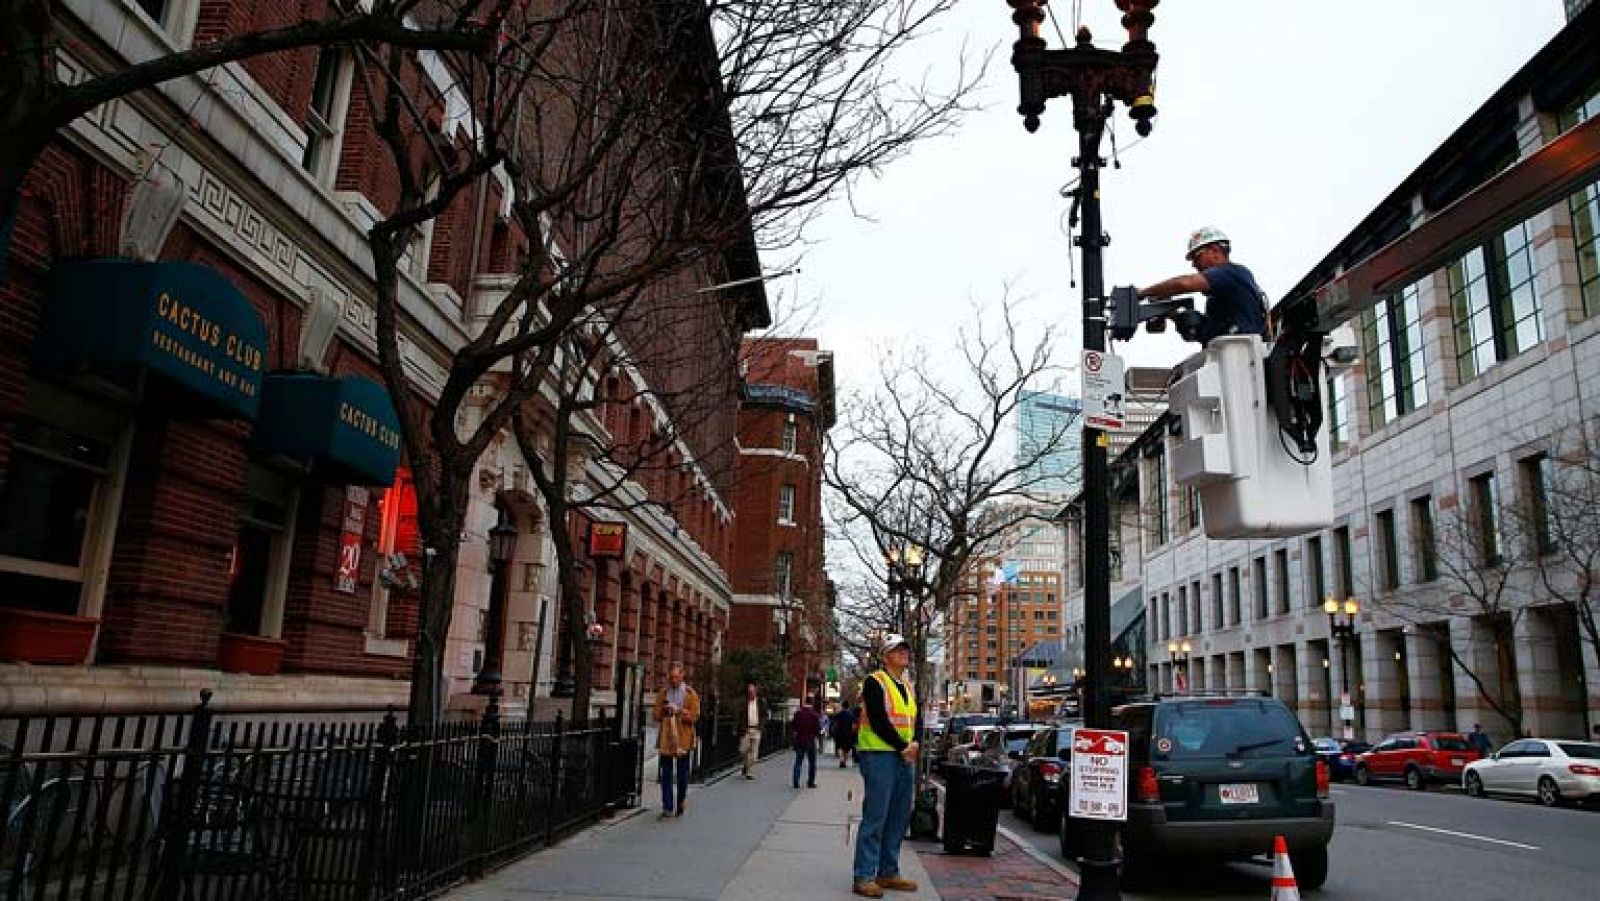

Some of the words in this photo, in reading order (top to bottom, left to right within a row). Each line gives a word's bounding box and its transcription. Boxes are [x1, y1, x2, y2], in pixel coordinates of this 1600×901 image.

[158, 292, 221, 348] CACTUS
[226, 335, 261, 371] CLUB
[340, 401, 378, 438] CACTUS
[1091, 756, 1109, 766] NO
